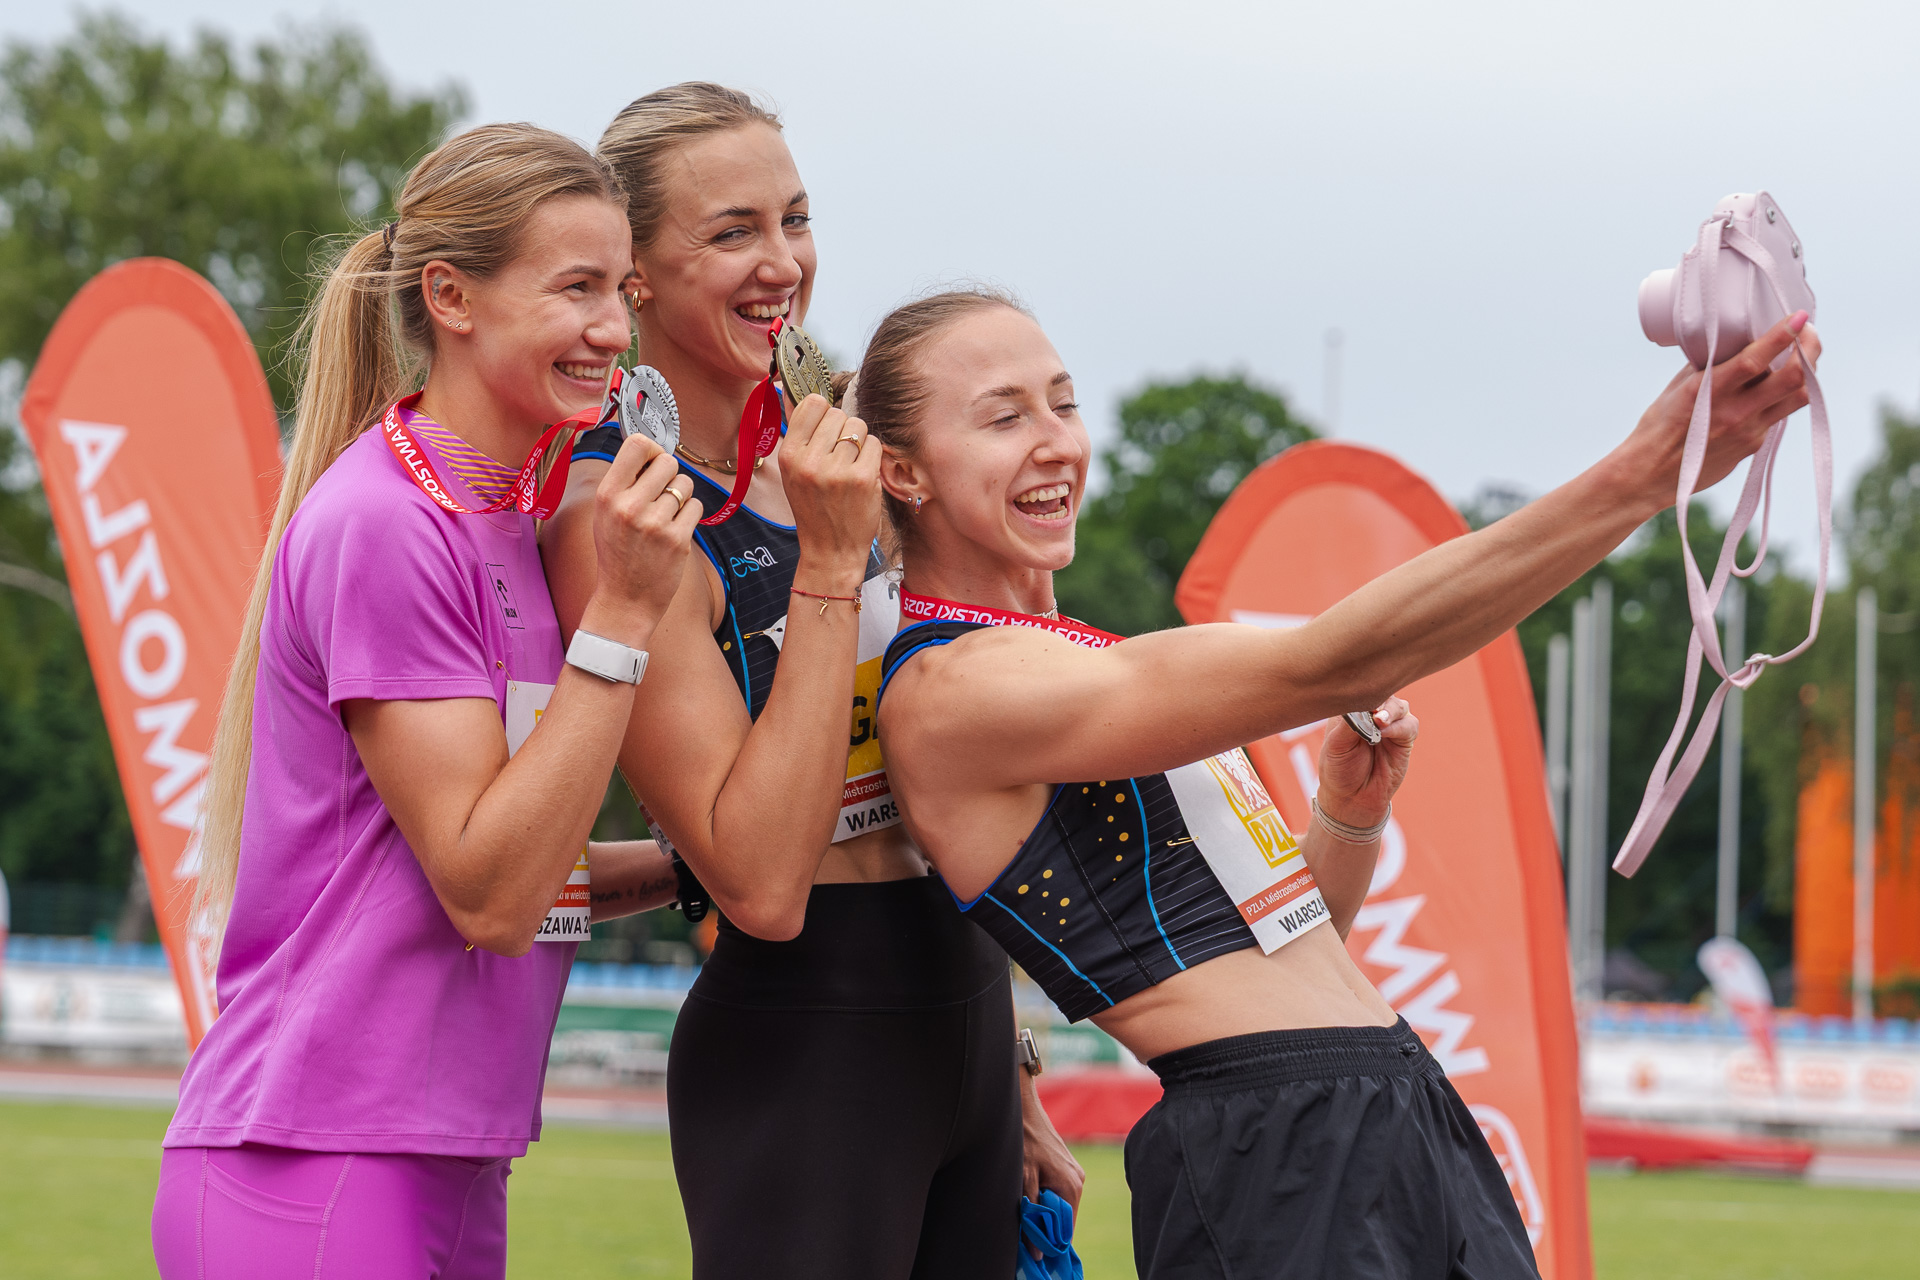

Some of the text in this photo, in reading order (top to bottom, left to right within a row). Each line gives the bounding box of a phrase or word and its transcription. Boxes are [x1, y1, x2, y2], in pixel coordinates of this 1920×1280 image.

[759, 427, 775, 454] 2025
[516, 446, 543, 491] 2025
[904, 597, 936, 617] 2025
[845, 801, 899, 832] WARS
[1245, 899, 1267, 916] PZLA
